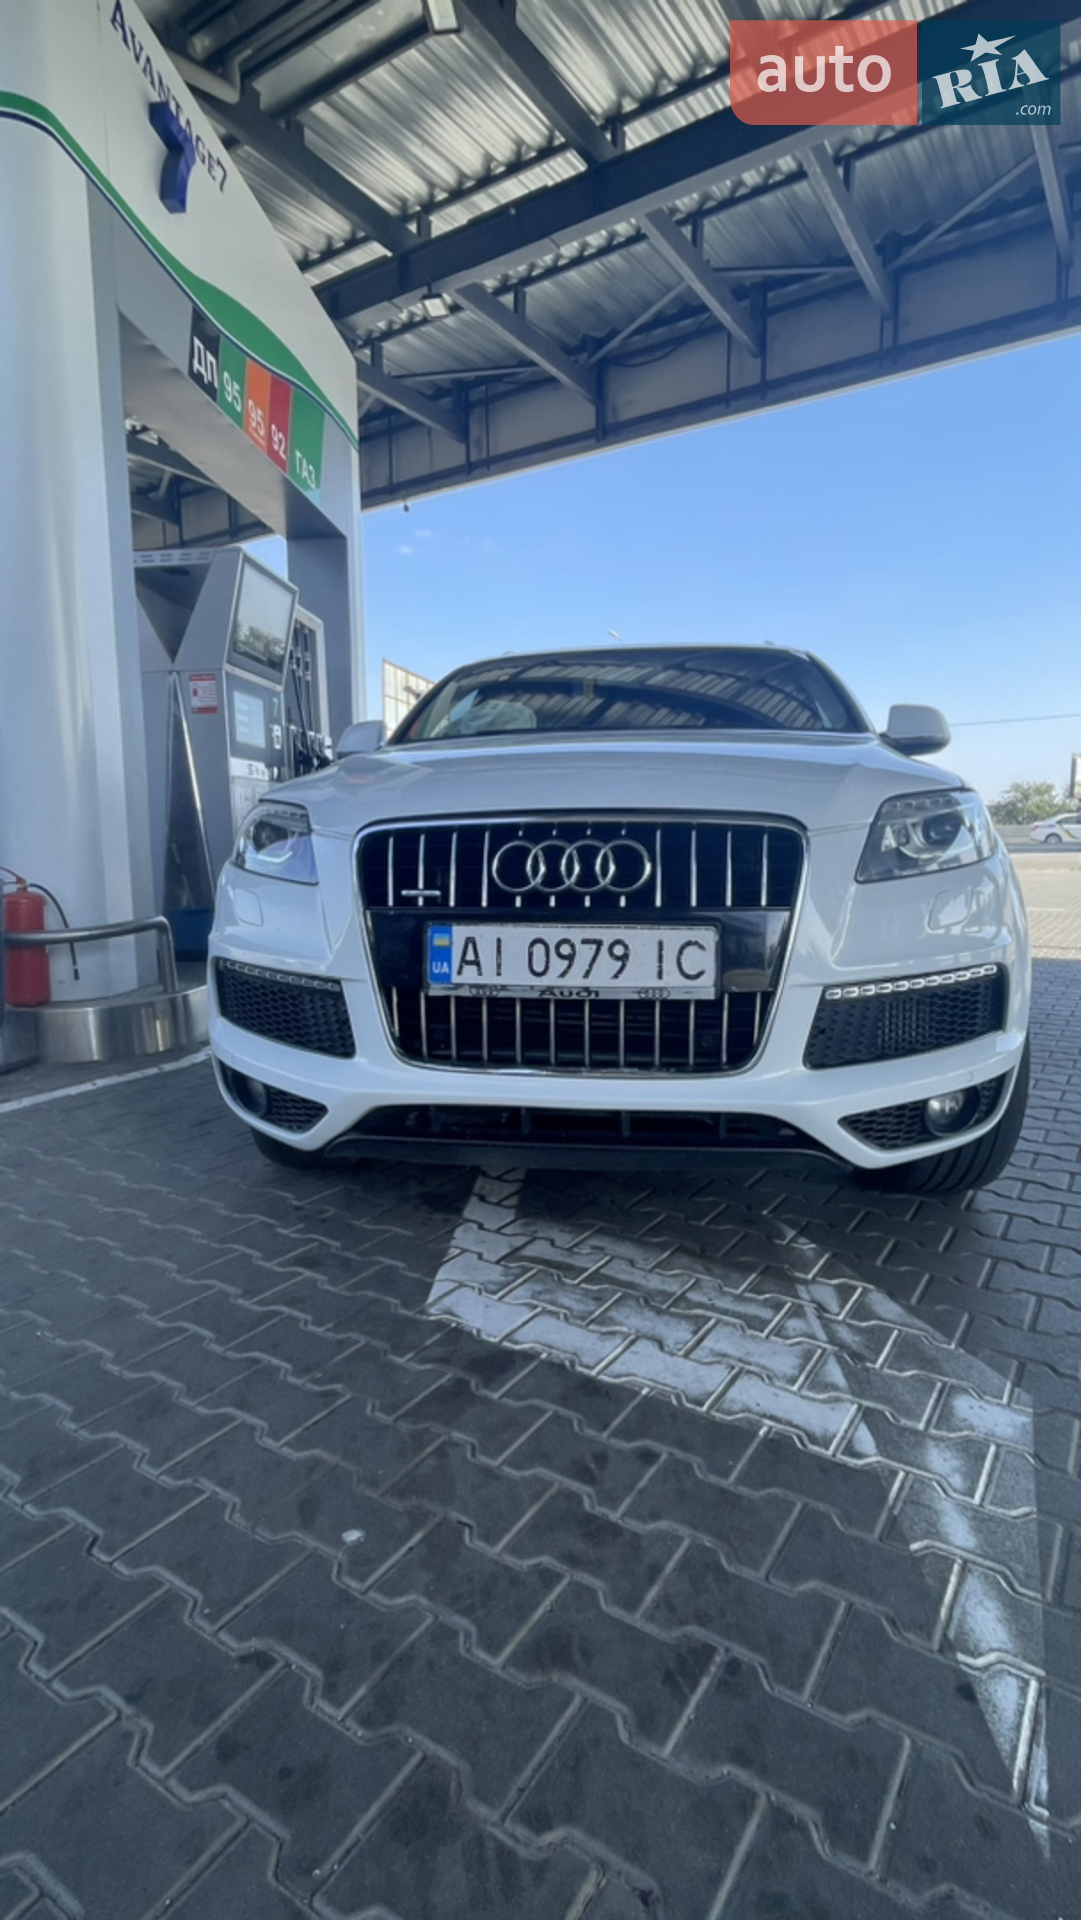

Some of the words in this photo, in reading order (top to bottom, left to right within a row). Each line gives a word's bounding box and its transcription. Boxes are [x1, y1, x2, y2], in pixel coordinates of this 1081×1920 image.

[192, 335, 219, 389] ДП
[223, 371, 242, 412] 95
[248, 399, 265, 437] 95
[271, 423, 287, 460] 92
[294, 449, 316, 490] ГАЗ
[432, 961, 450, 974] UA
[456, 936, 502, 977] AI
[528, 937, 631, 980] 0979
[656, 938, 707, 981] IC
